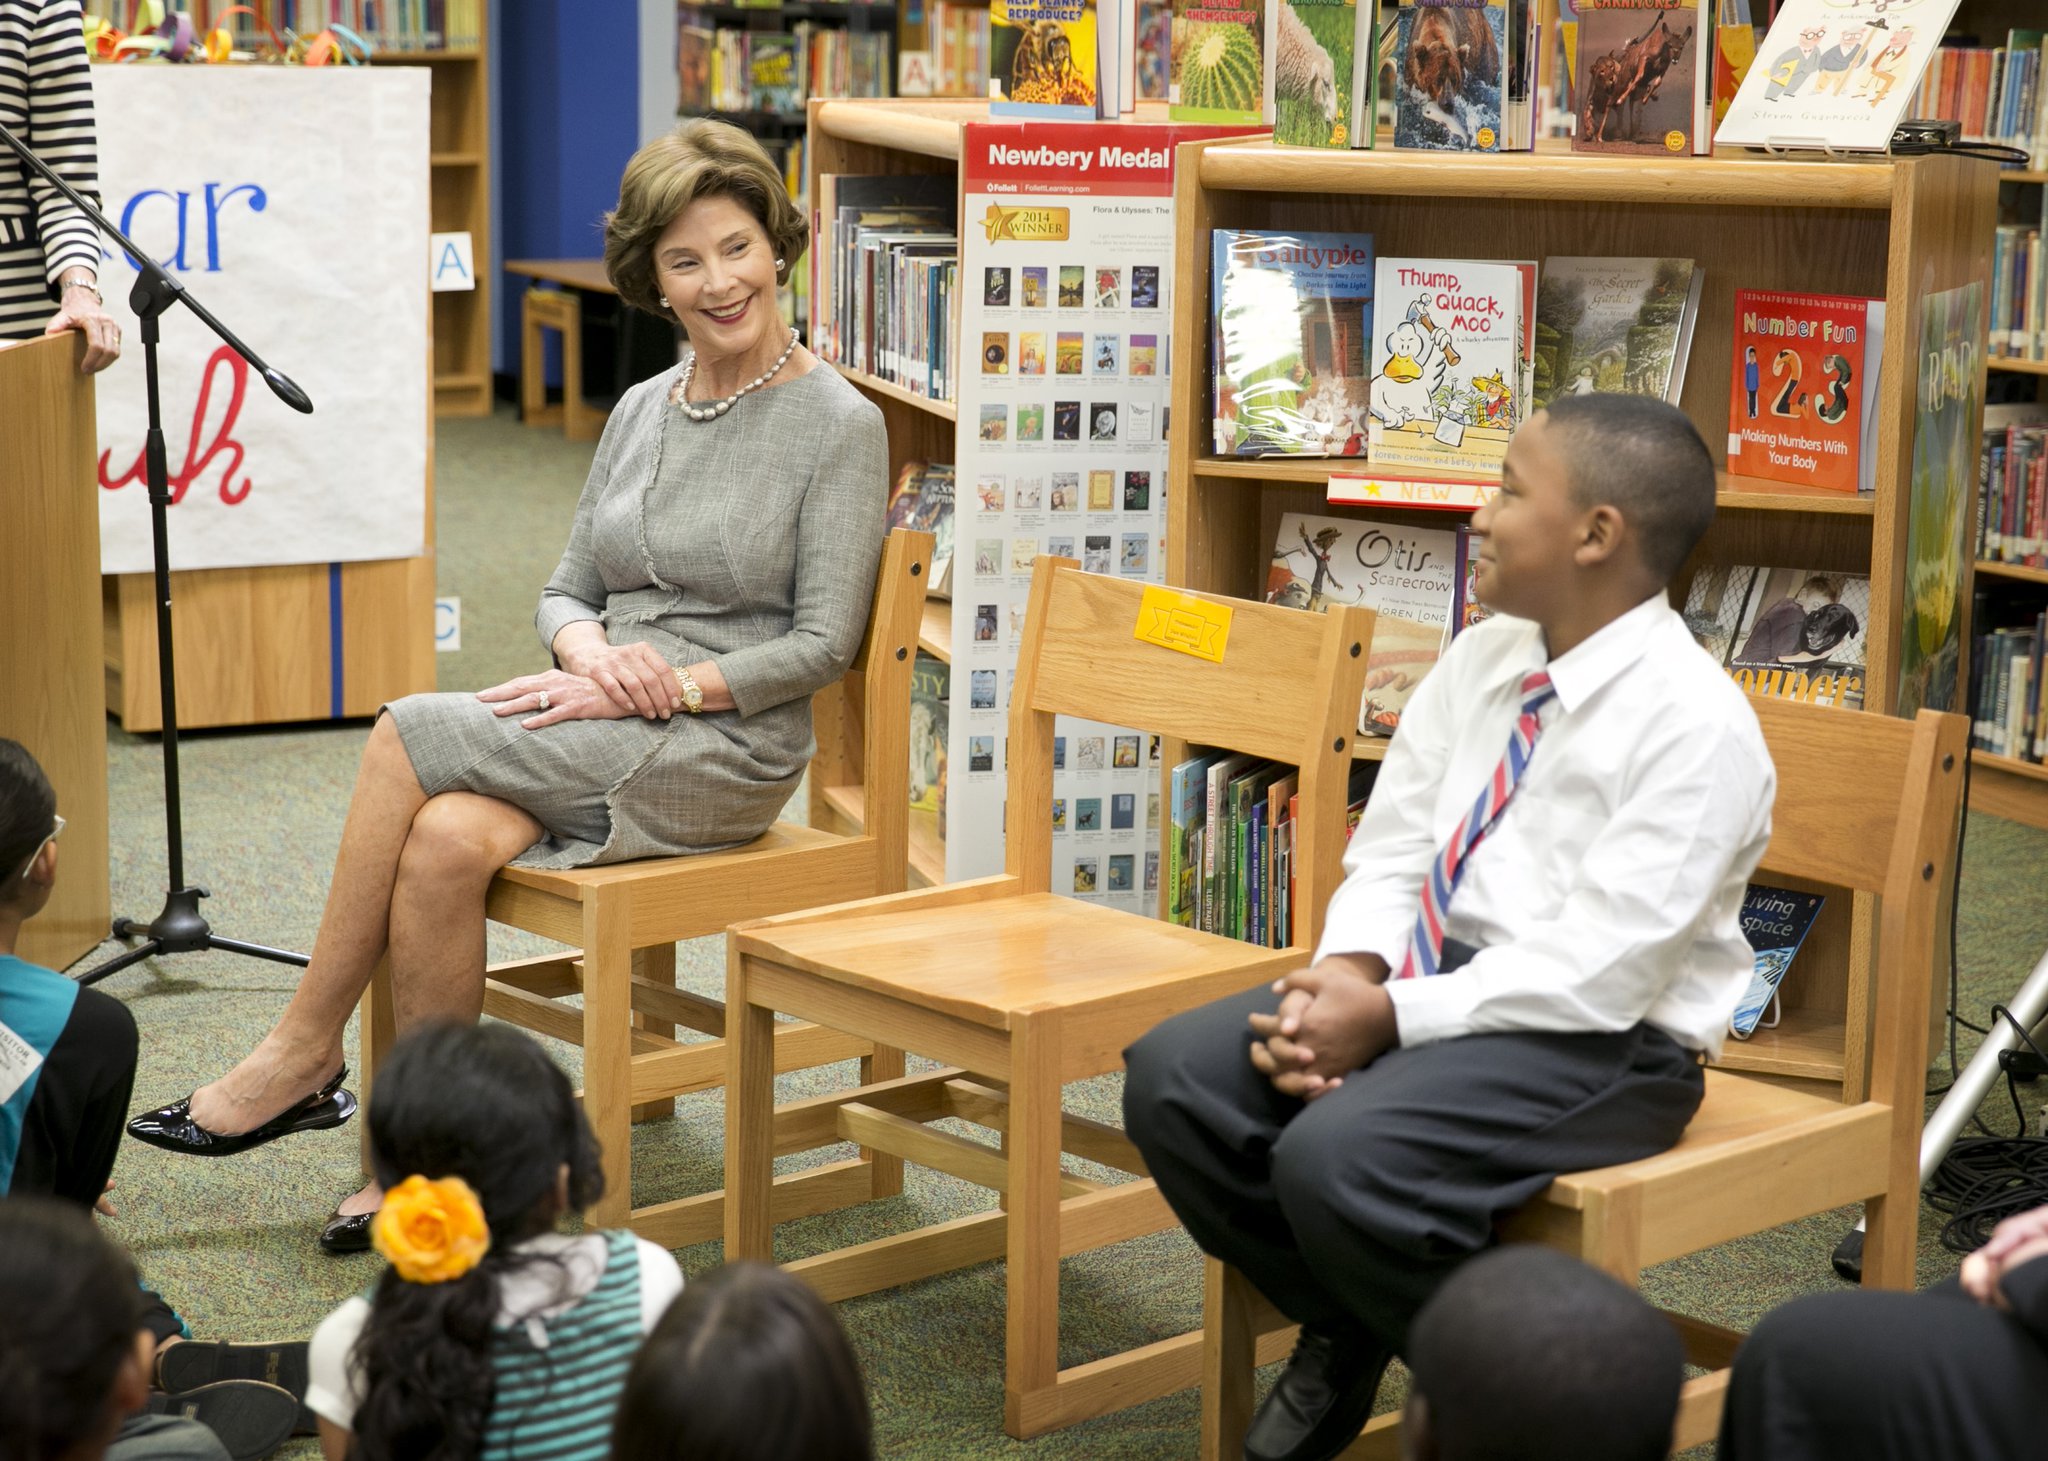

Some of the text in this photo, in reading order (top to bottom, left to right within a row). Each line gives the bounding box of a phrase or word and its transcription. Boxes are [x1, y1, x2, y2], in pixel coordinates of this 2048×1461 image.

[1008, 9, 1082, 21] REPRODUCE?
[1186, 9, 1257, 23] THEMSELVES?
[903, 58, 928, 88] A
[989, 144, 1170, 171] Newbery Medal
[994, 184, 1091, 194] Follett FollettLearning.com
[1023, 211, 1050, 223] 2014
[1093, 206, 1112, 214] Flora
[1121, 207, 1153, 216] Ulysses:
[1155, 207, 1170, 215] The
[1010, 222, 1063, 234] WINNER
[438, 241, 467, 280] A
[1259, 243, 1366, 270] Saltypie
[1350, 281, 1367, 290] Light
[1397, 268, 1462, 293] Thump,
[1603, 273, 1646, 290] Secret
[1436, 293, 1504, 320] Quack,
[1588, 289, 1634, 310] Garden
[1743, 312, 1857, 343] Number Fun
[1928, 341, 1973, 413] READ
[1740, 428, 1848, 455] Making Numbers With
[1374, 450, 1401, 460] doreen
[1403, 452, 1432, 463] cronin
[1434, 454, 1449, 465] and
[1450, 456, 1477, 470] betsy
[1768, 450, 1818, 473] Your Body
[1400, 482, 1452, 500] NEW
[1355, 529, 1446, 573] Otis AND
[1369, 570, 1454, 593] Scarecrow THE
[1376, 604, 1447, 623] LOREN LONG
[1206, 820, 1214, 855] THROUGH
[1206, 856, 1214, 873] TIME
[1205, 888, 1213, 930] ILLUSTRATED
[1743, 889, 1797, 921] Living
[1741, 916, 1794, 937] space
